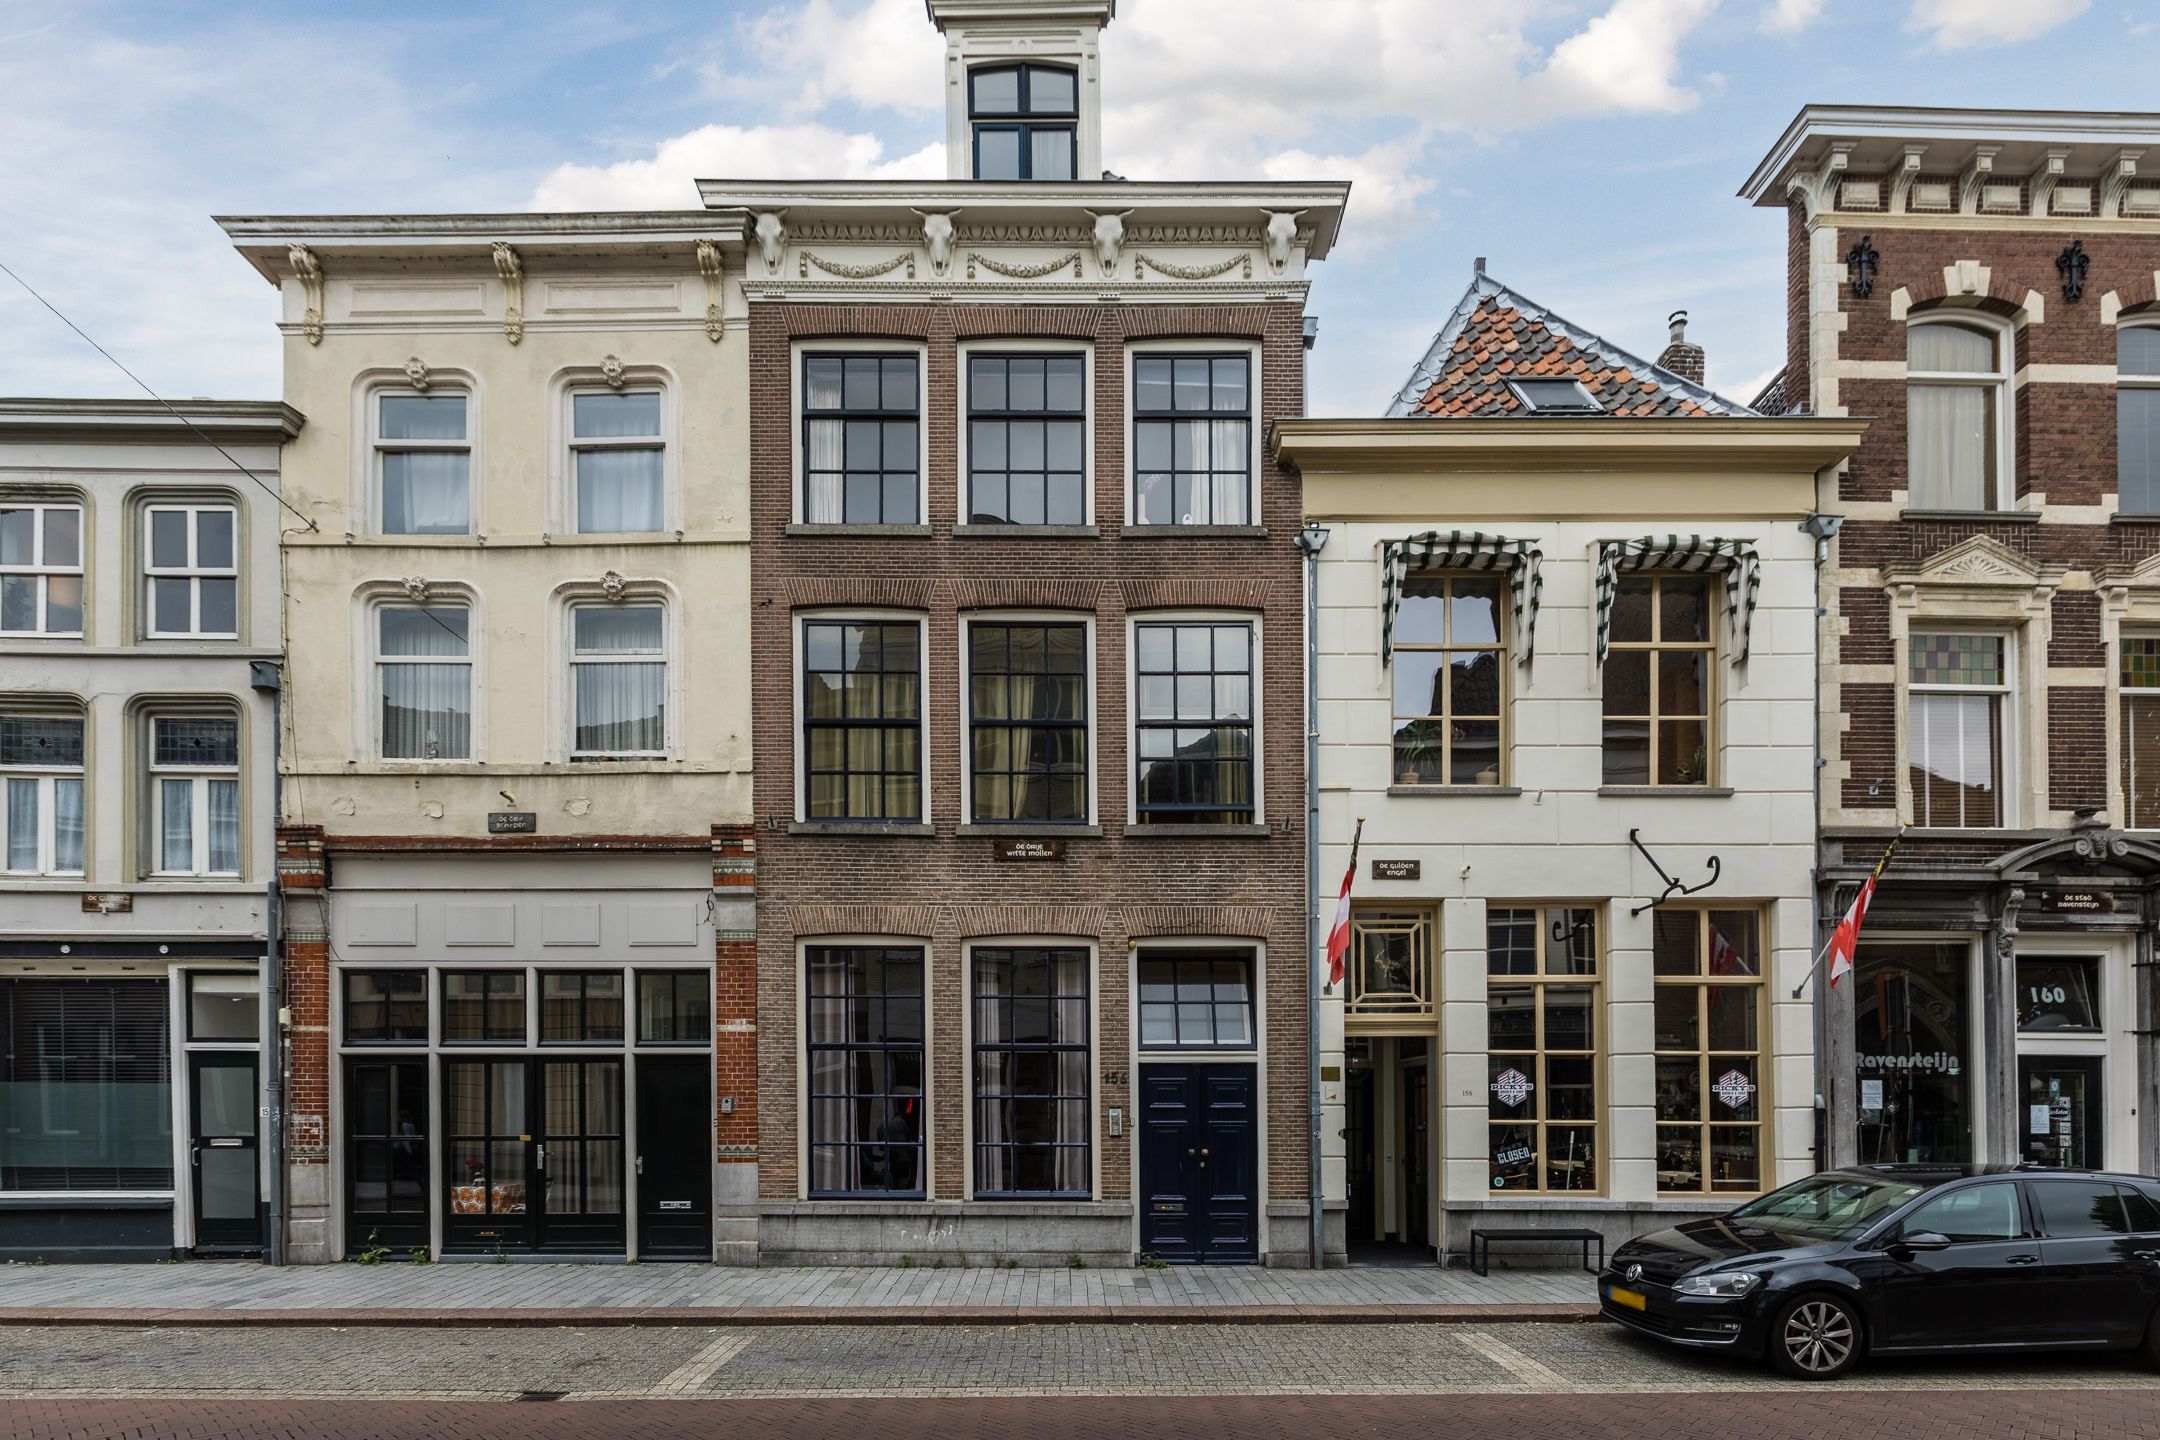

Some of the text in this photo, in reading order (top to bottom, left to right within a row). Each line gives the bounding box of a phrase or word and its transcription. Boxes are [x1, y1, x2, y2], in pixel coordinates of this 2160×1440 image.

[1389, 861, 1414, 869] gulden
[1386, 868, 1407, 876] engel
[2031, 986, 2066, 1004] 160
[1856, 1051, 1959, 1072] Ravensteijn
[1104, 1071, 1129, 1084] 156
[1462, 1089, 1473, 1097] 158
[1497, 1147, 1530, 1164] CLOSED
